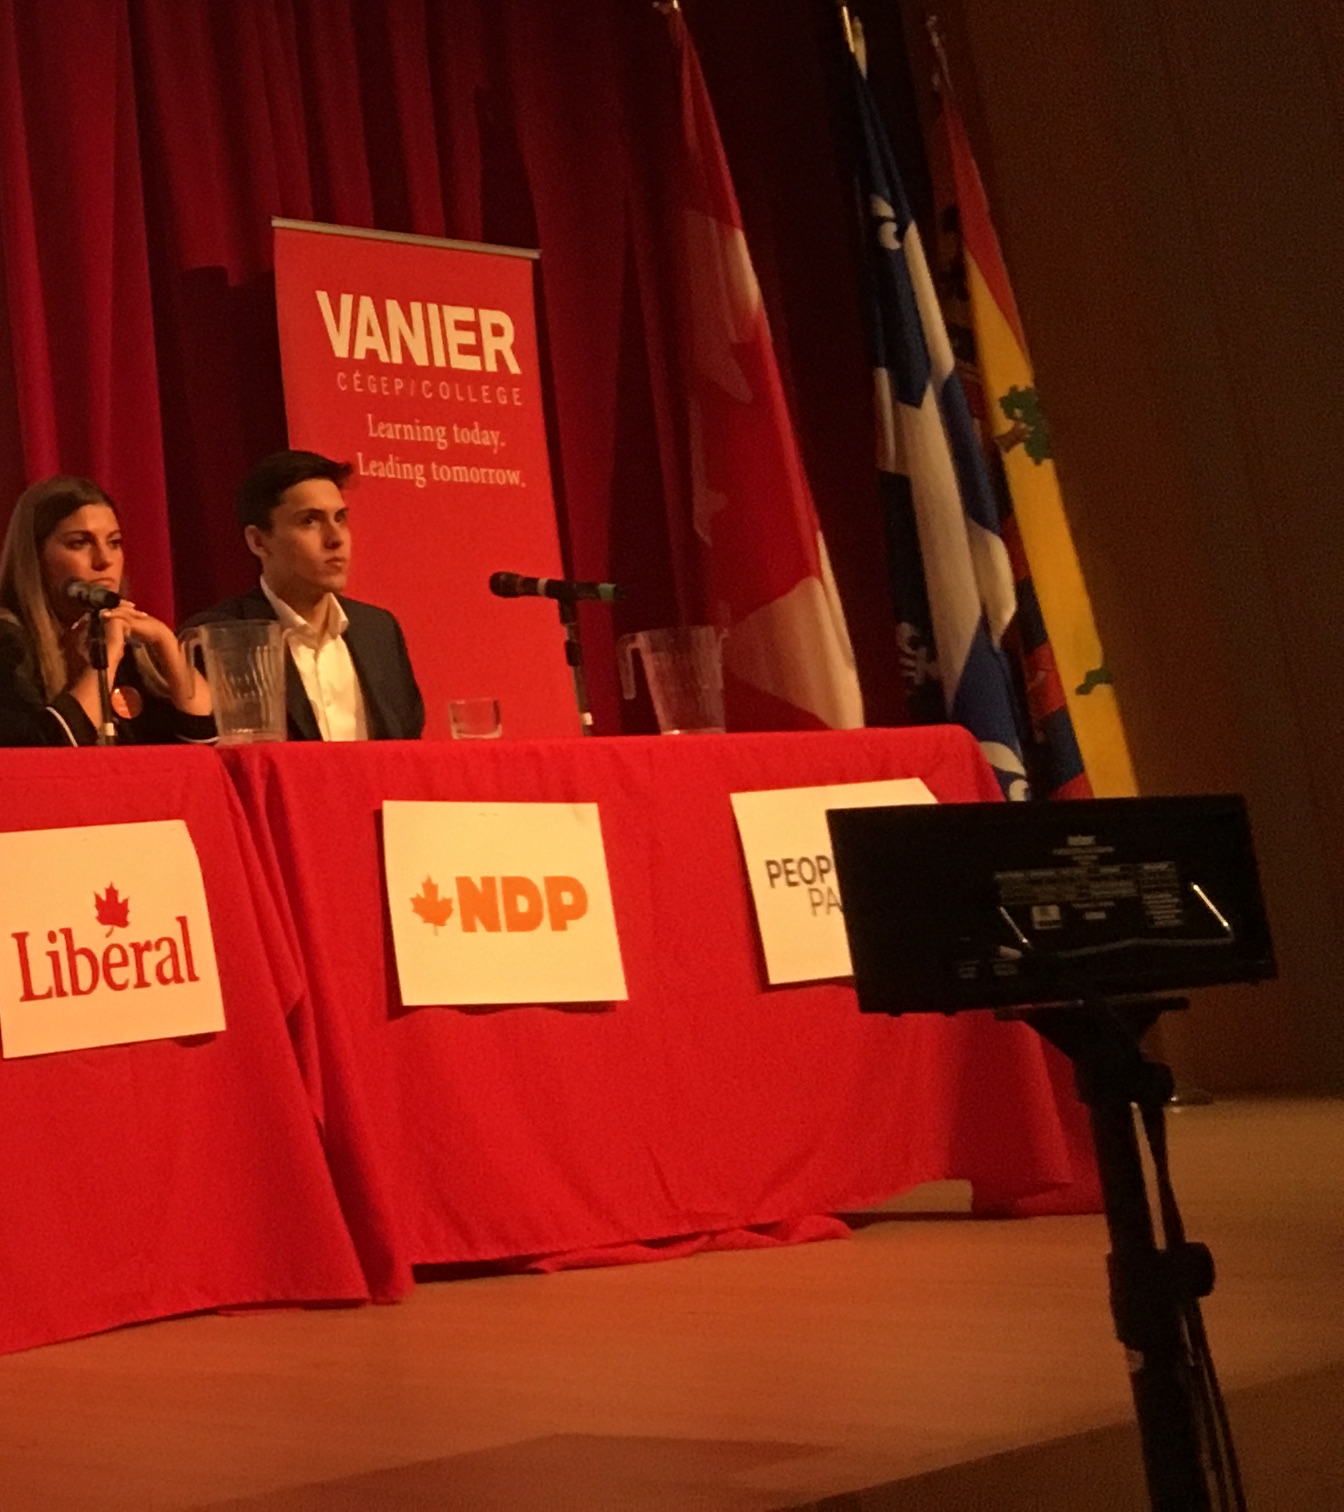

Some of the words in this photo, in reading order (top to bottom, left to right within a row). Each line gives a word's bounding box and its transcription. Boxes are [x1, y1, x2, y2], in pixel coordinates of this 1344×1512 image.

[316, 290, 522, 374] VANIER
[367, 413, 448, 450] Learning
[452, 421, 506, 454] today.
[357, 452, 427, 488] Leading
[431, 461, 526, 488] tomorrow.
[765, 854, 834, 889] PEOP
[455, 875, 588, 933] NDP
[808, 886, 844, 917] PA
